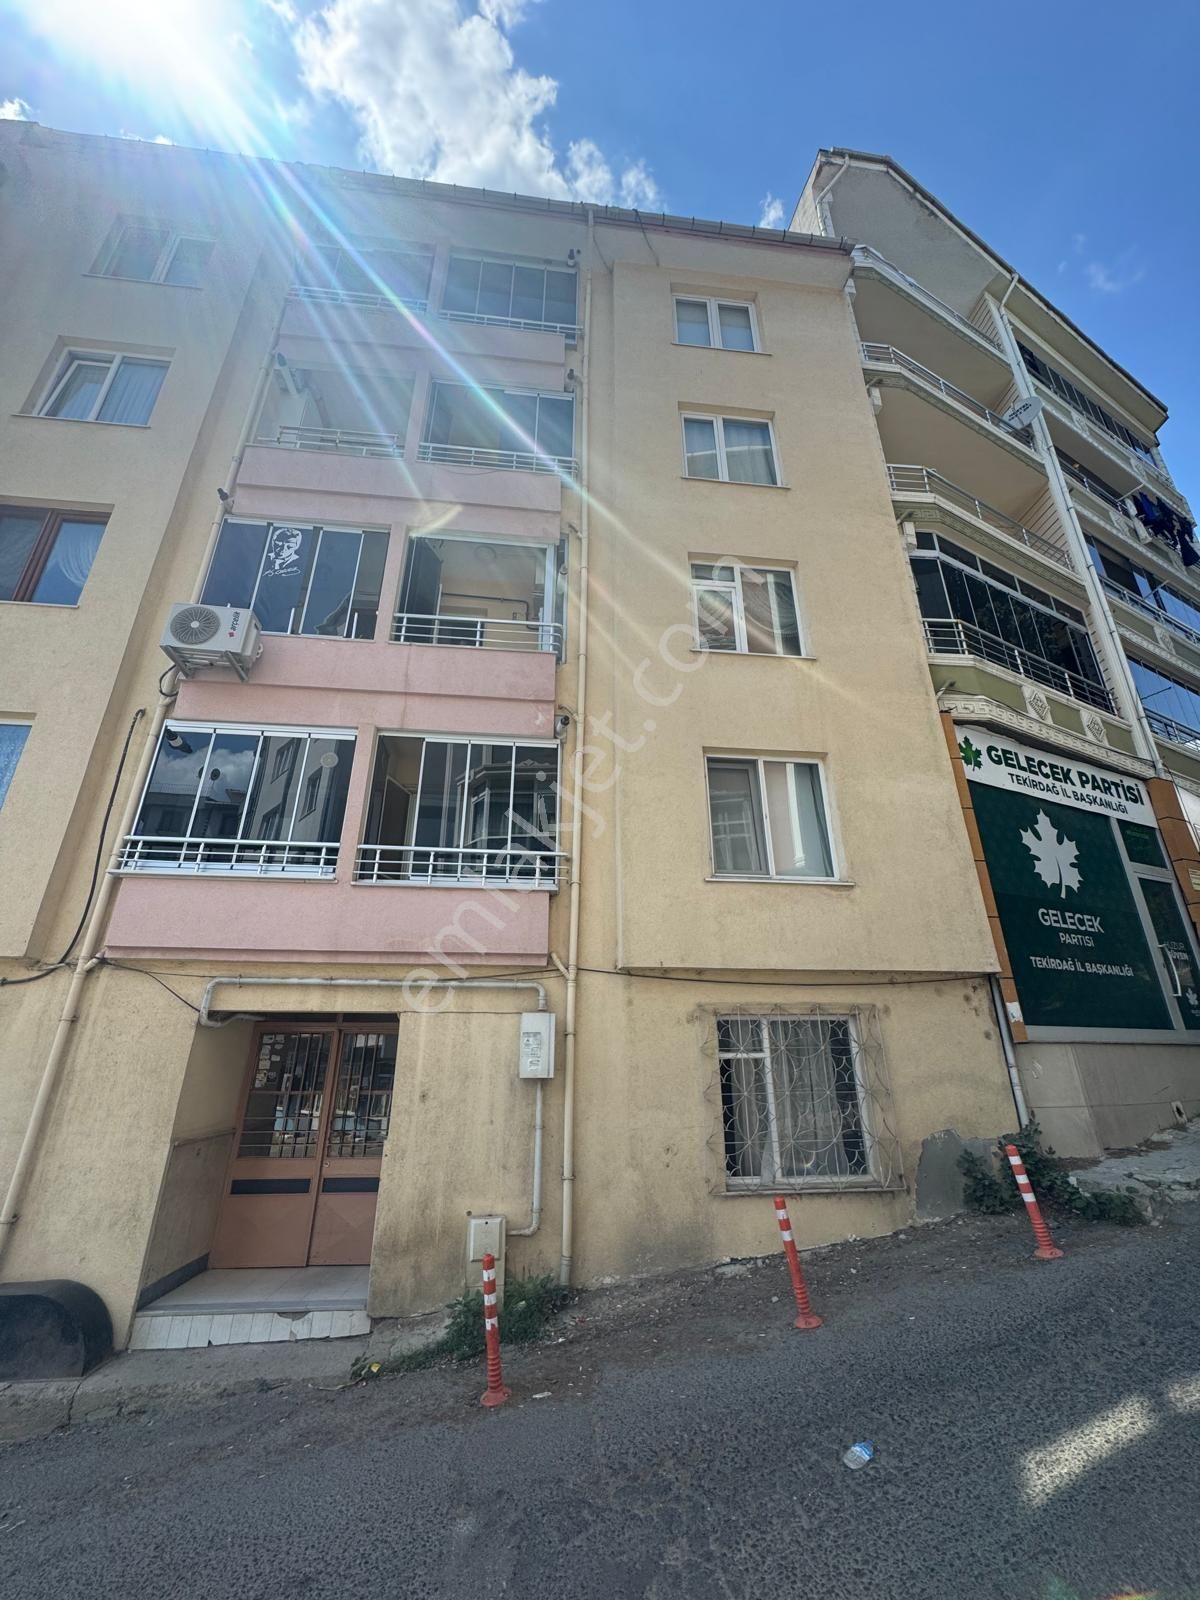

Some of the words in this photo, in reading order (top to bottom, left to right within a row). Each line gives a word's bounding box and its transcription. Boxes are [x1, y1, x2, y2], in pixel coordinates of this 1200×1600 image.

[986, 745, 1074, 788] GELECEK
[1077, 770, 1145, 806] PARTİSİ
[1008, 772, 1059, 796] TEKİRDAĞ
[1060, 786, 1071, 798] İL
[1073, 791, 1129, 814] BAŞKANLIĞI
[1038, 908, 1104, 933] GELECEK
[1030, 955, 1075, 971] TEKİRDAĞ
[1075, 959, 1085, 972] İL
[1085, 962, 1135, 977] BAŞKANLIĞI
